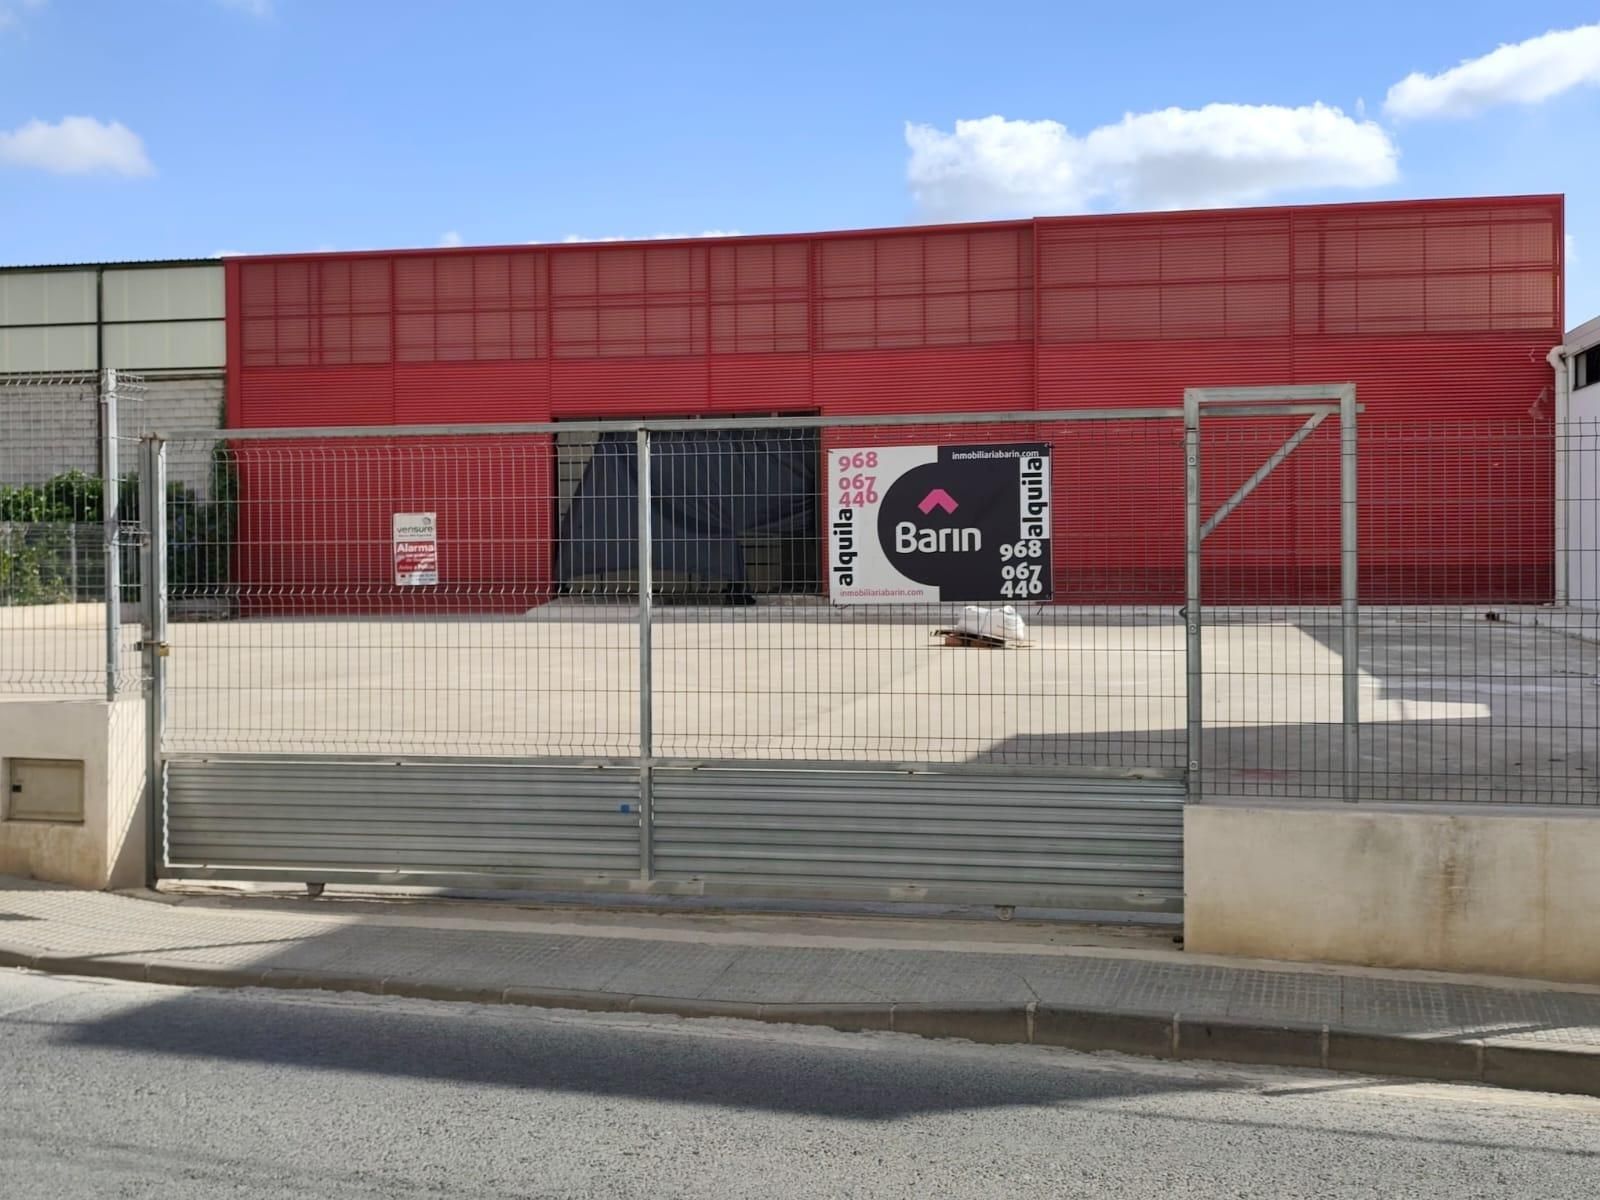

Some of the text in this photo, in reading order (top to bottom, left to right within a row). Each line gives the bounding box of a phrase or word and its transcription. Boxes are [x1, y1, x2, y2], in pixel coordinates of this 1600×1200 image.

[838, 451, 878, 472] 968
[952, 450, 1039, 460] inmobiliariabarin.com
[838, 473, 878, 494] 067
[838, 490, 878, 508] 440
[1022, 458, 1048, 537] alquila
[833, 508, 858, 586] alquila
[895, 521, 982, 553] Barin
[397, 543, 434, 553] Alarma
[1000, 540, 1042, 562] 968
[1001, 561, 1043, 582] 067
[840, 588, 924, 598] inmobiliariabarin.com
[1000, 579, 1043, 598] 440
